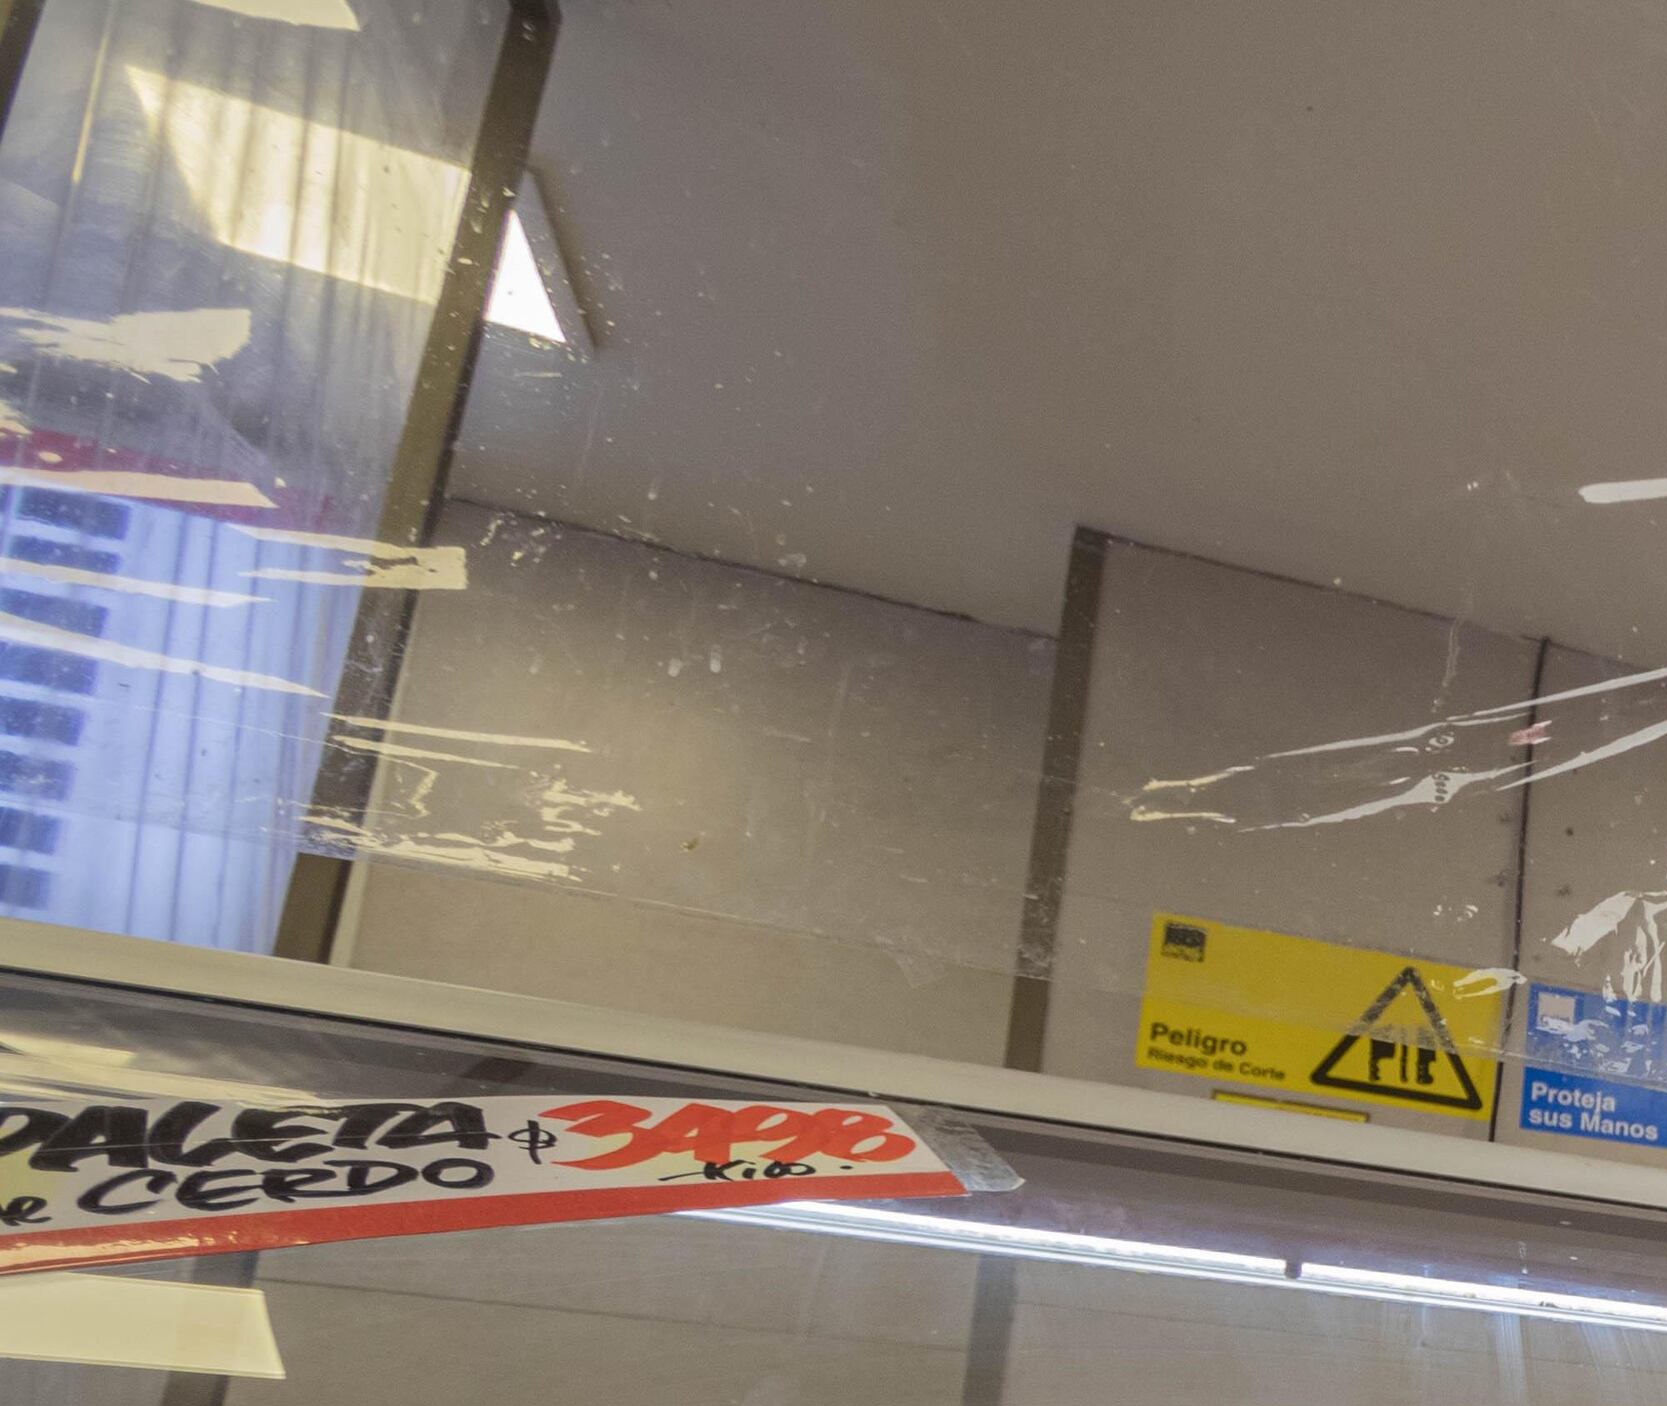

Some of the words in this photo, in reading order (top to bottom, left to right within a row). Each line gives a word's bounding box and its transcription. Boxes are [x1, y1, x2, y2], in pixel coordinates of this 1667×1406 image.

[1151, 1022, 1247, 1056] Peligro
[1147, 1046, 1208, 1069] Riesgo
[1212, 1060, 1234, 1072] de
[1239, 1062, 1286, 1080] Corte
[1531, 1081, 1616, 1112] Proteja
[1529, 1108, 1573, 1129] sus
[1580, 1112, 1659, 1141] Manos
[78, 1158, 494, 1214] CERDO
